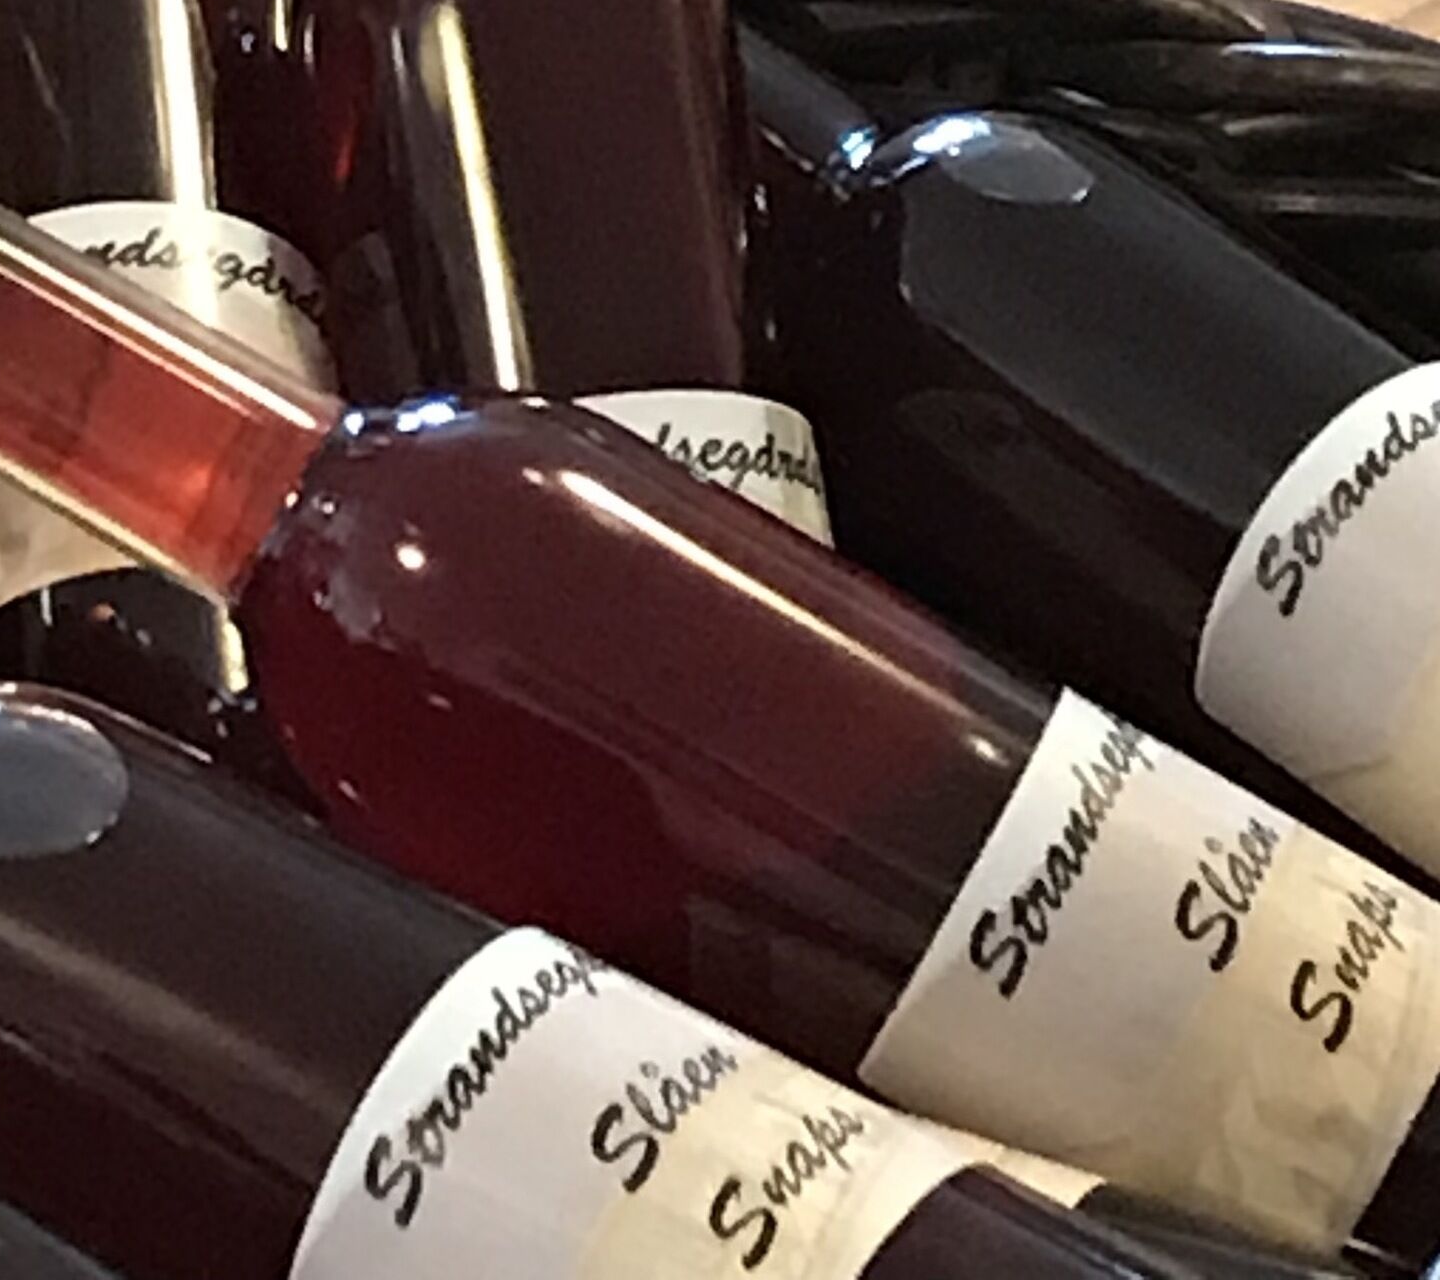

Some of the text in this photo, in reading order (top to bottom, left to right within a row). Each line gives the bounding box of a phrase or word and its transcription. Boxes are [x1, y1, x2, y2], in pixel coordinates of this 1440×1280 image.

[1173, 815, 1281, 973] Slåen
[1289, 879, 1406, 1054] Snaps
[590, 1040, 738, 1194] Slåen
[708, 1104, 866, 1270] Snaps
